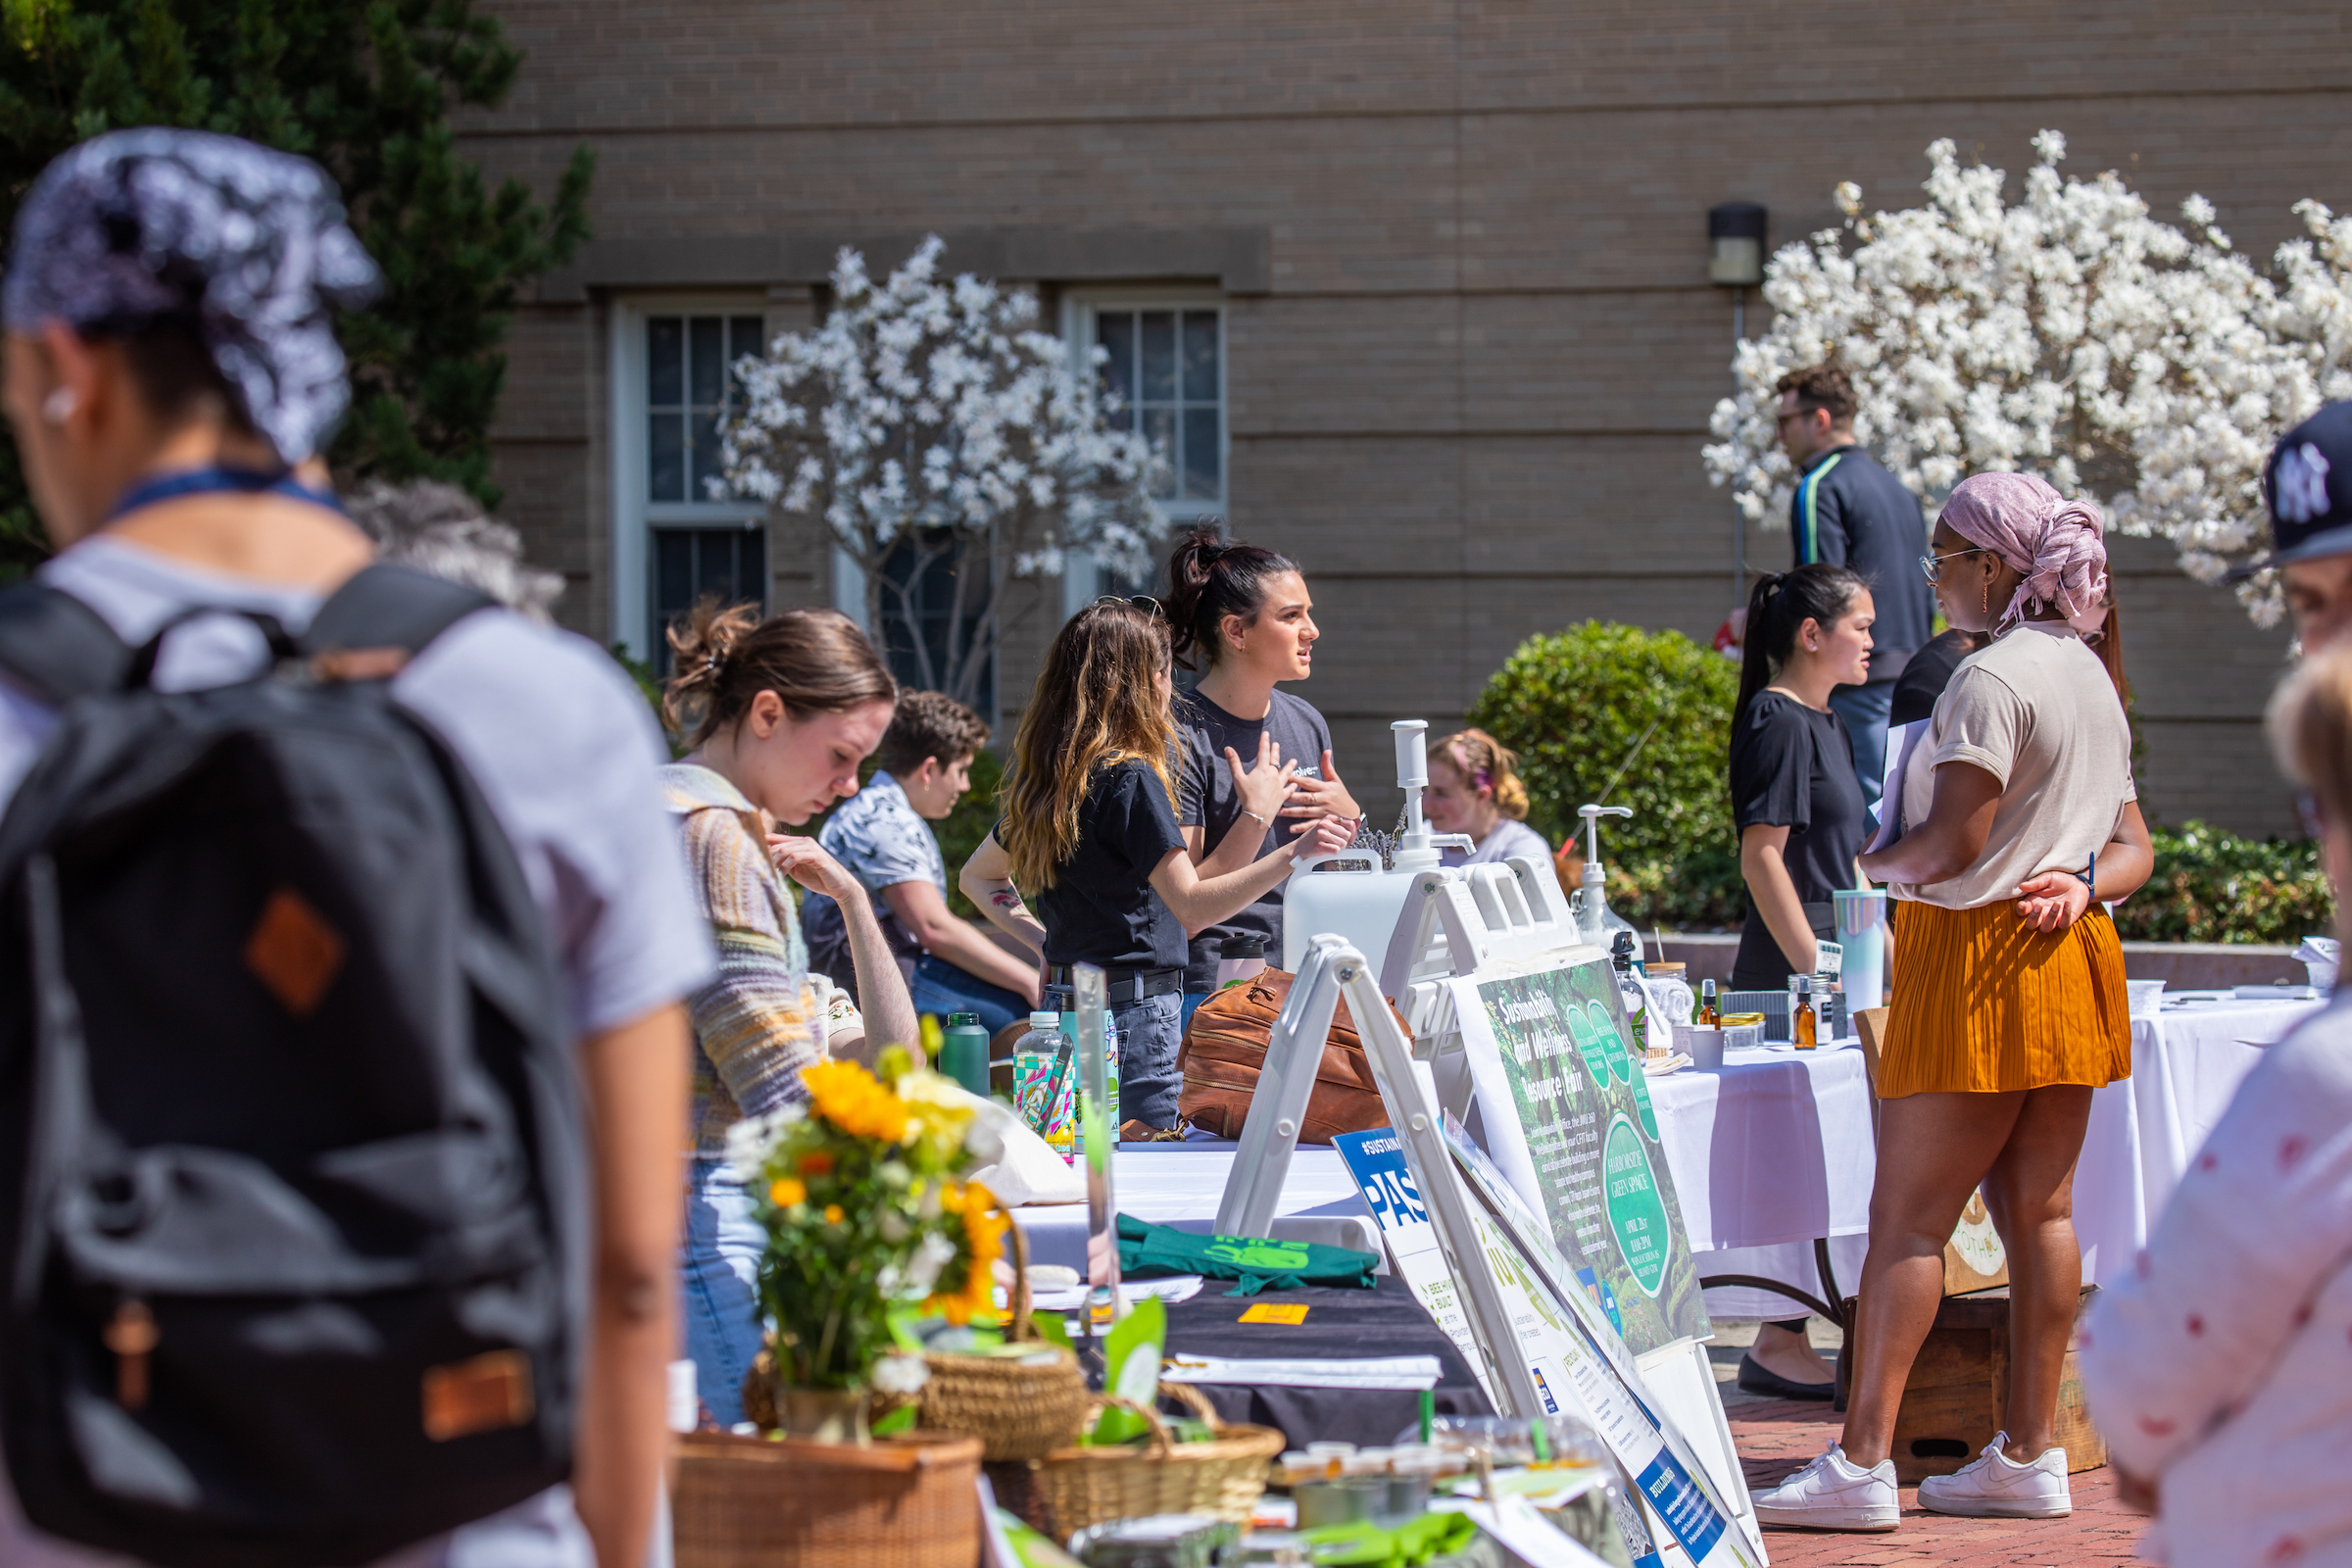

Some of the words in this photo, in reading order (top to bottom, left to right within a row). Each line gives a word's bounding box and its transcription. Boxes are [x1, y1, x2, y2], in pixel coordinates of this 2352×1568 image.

[1498, 989, 1560, 1025] Sustainability
[1514, 1032, 1532, 1064] and
[1531, 1028, 1572, 1059] Wellness
[1521, 1076, 1563, 1103] Resource
[1562, 1064, 1584, 1094] Fair
[1580, 1113, 1589, 1126] JWU
[1588, 1111, 1596, 1124] 360
[1585, 1129, 1598, 1144] faculty
[1571, 1151, 1587, 1165] building
[1589, 1150, 1600, 1159] more
[1608, 1150, 1643, 1174] HARBORSIDE
[1611, 1176, 1629, 1198] GREEN
[1628, 1173, 1649, 1194] SPACE
[1625, 1218, 1639, 1235] APRIL
[1954, 1222, 2001, 1259] OTHEC
[1428, 1282, 1444, 1295] BEE
[1435, 1295, 1453, 1309] BUILT
[1649, 1466, 1676, 1499] BUILDINGS
